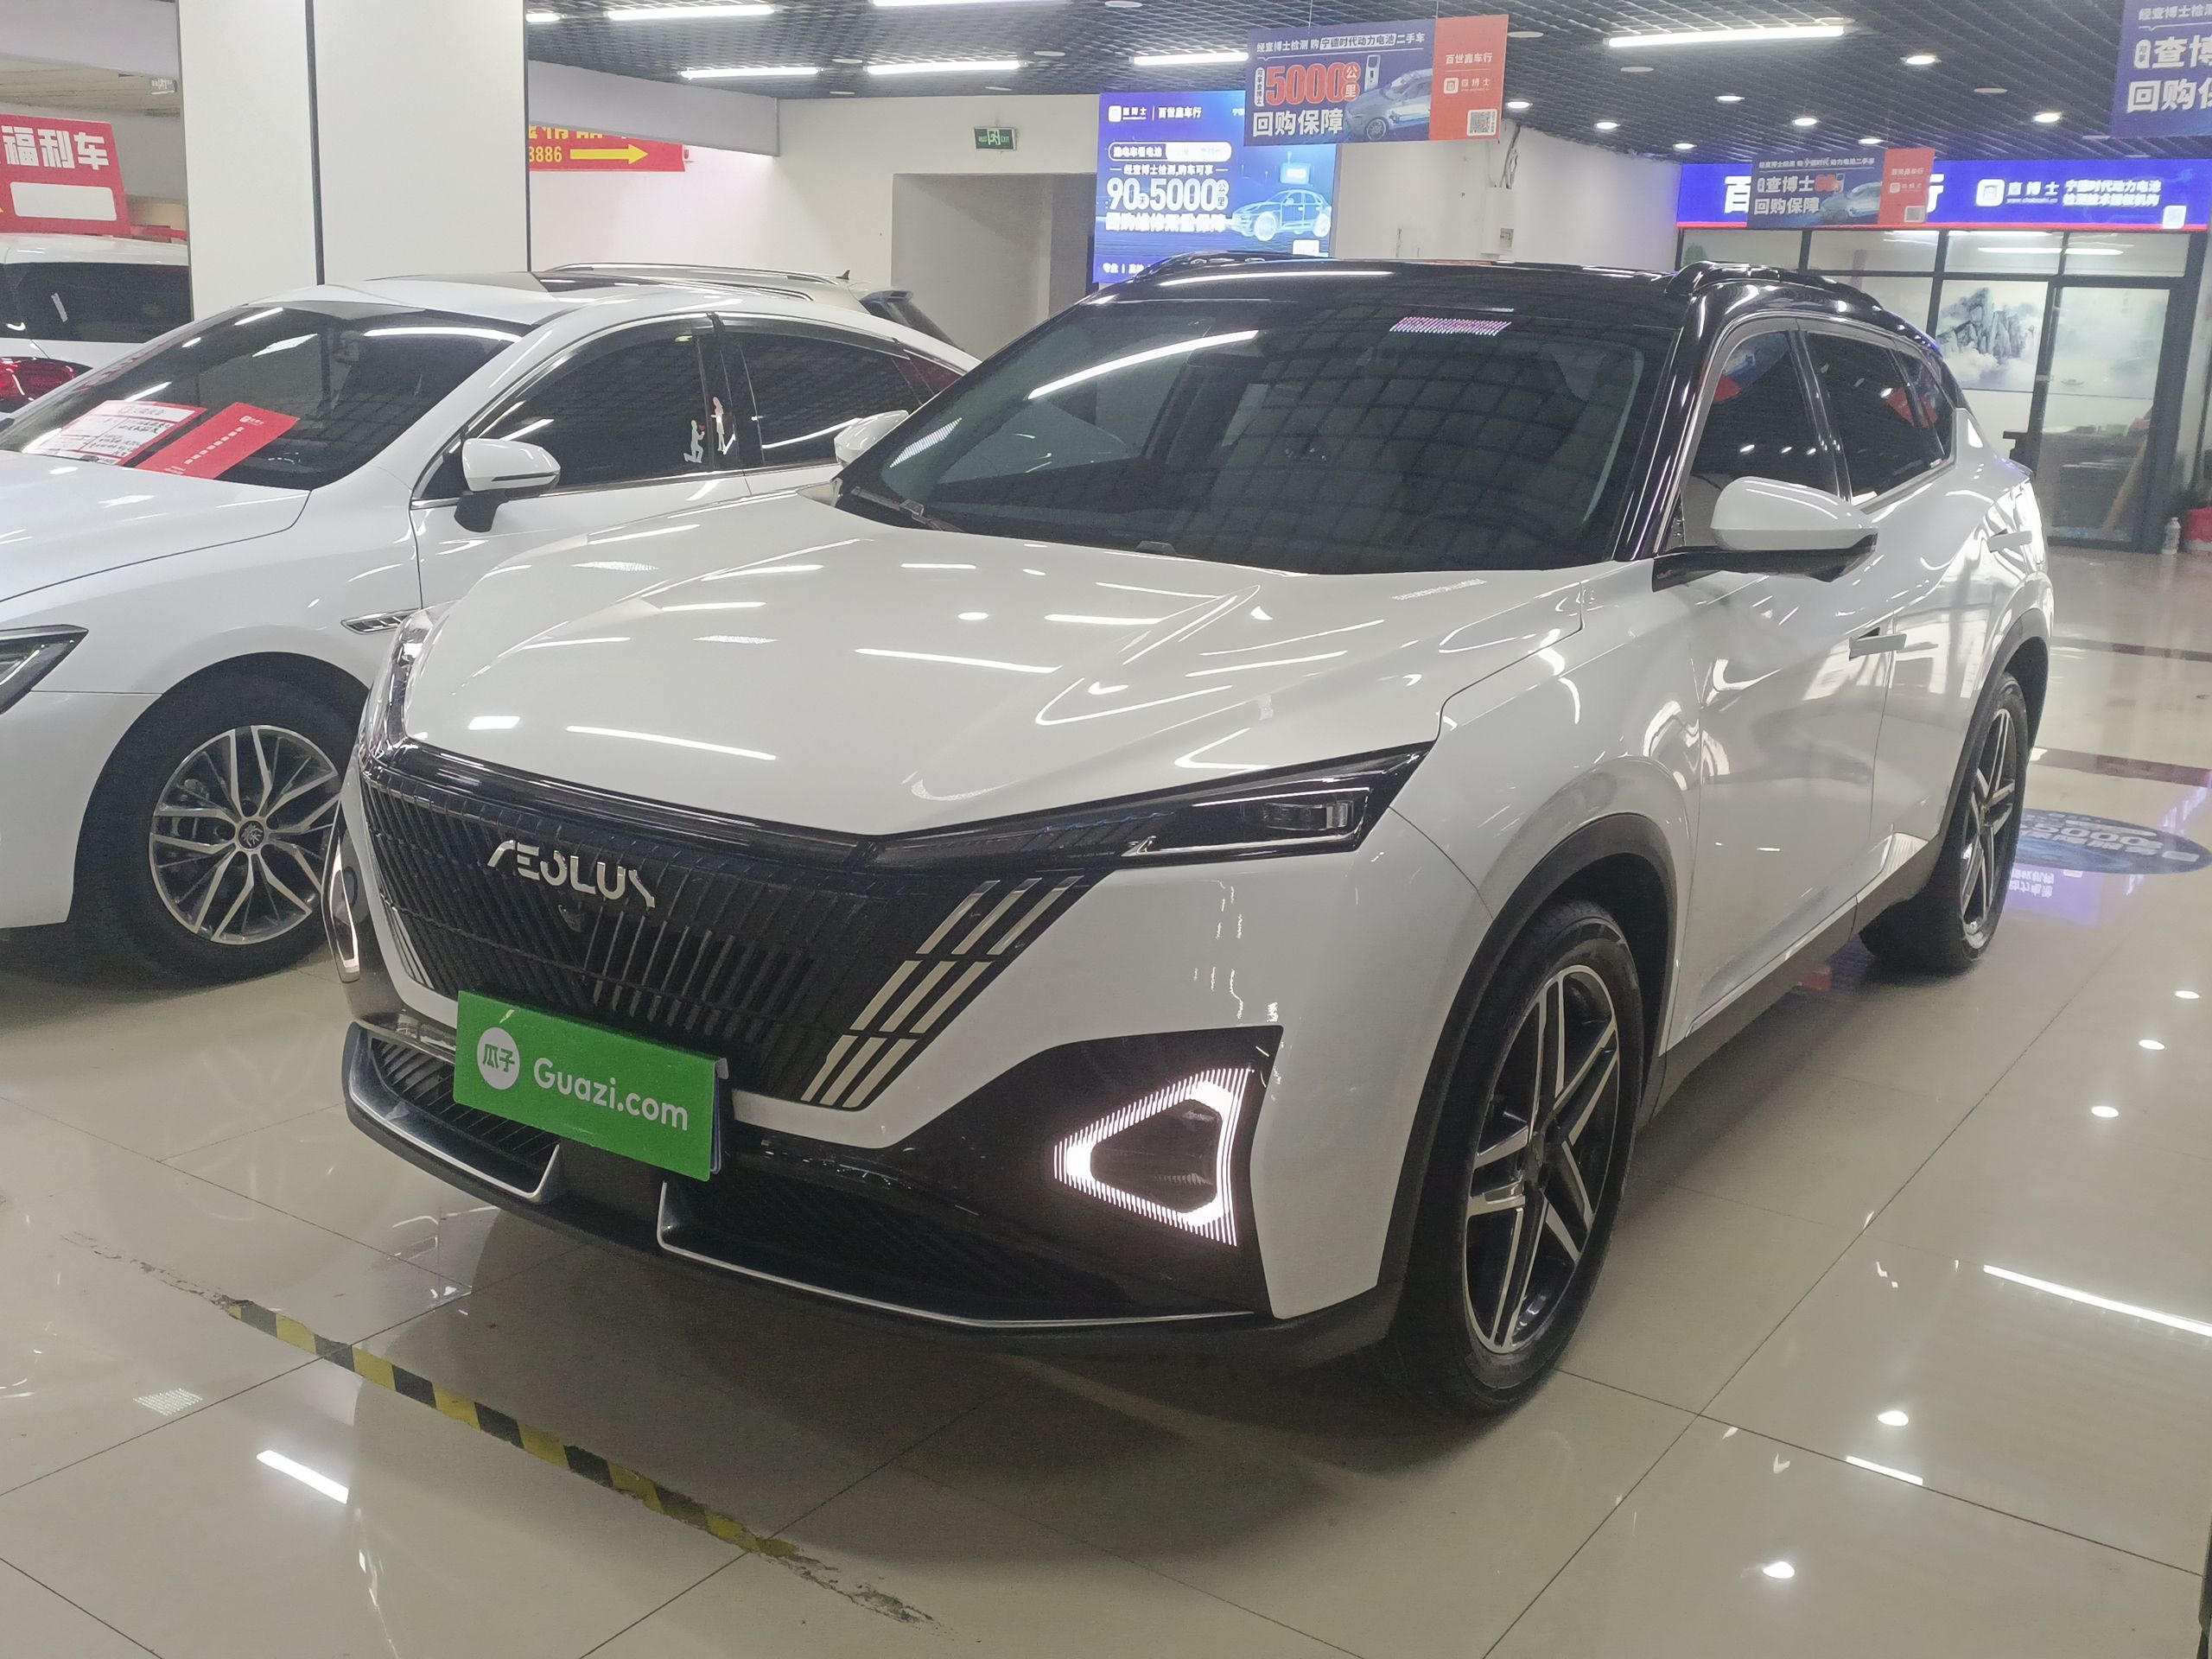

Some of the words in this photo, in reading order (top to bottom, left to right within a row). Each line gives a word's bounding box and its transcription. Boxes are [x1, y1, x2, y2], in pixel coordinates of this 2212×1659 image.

[1266, 62, 1345, 105] 5000
[1253, 108, 1344, 137] 回购保障
[1, 125, 109, 170] 福利车
[1107, 177, 1141, 211] 90
[1754, 197, 1820, 215] 回购保障
[482, 1044, 516, 1072] 瓜子
[533, 1057, 688, 1131] Guazi.com
